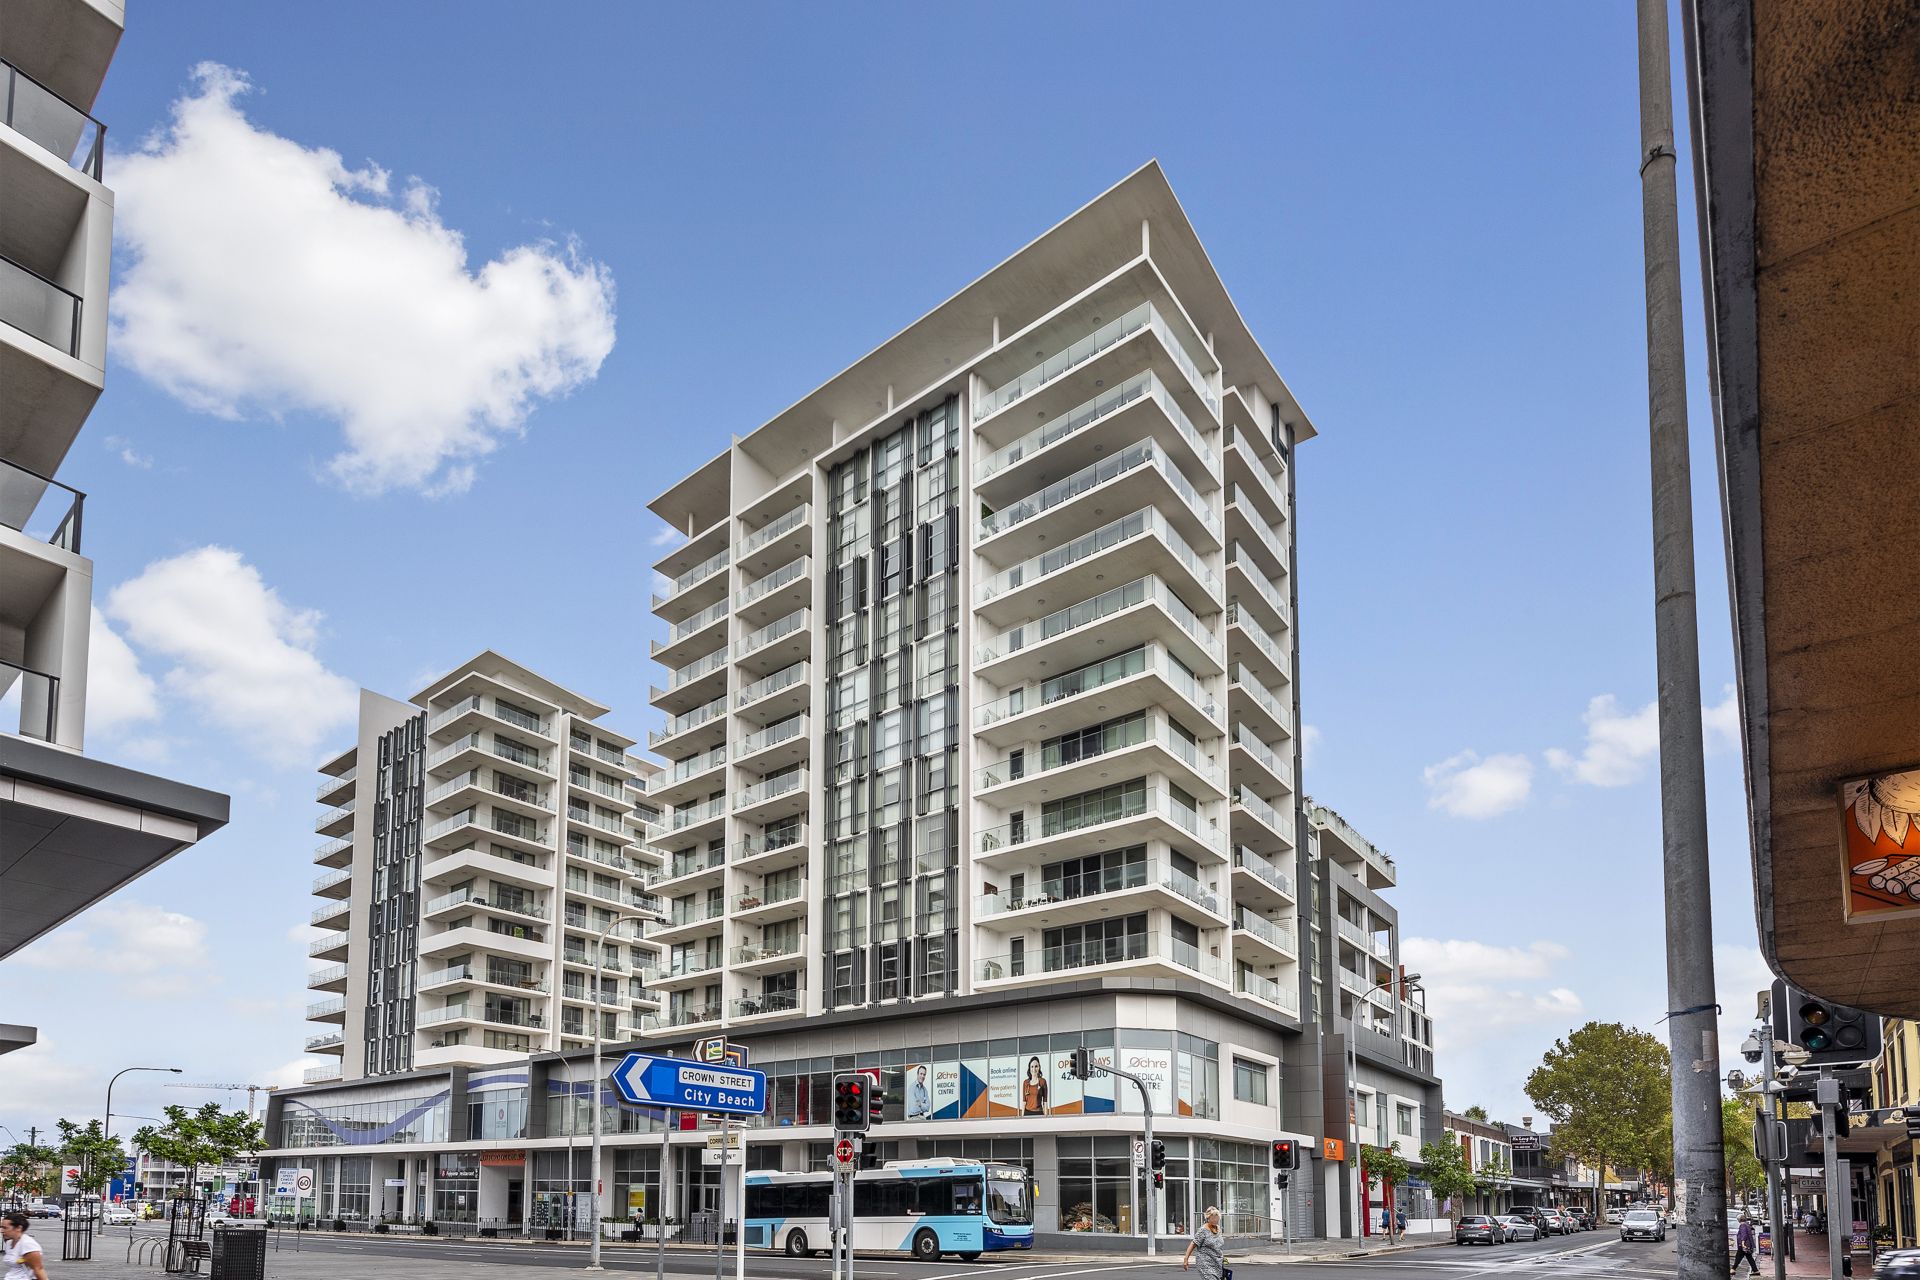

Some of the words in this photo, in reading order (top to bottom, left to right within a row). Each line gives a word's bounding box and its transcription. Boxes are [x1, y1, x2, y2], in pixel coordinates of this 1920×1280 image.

[991, 1067, 1002, 1075] Book
[1003, 1066, 1017, 1074] online
[682, 1071, 715, 1084] CROWN
[719, 1075, 752, 1088] STREET
[1129, 1072, 1164, 1082] EDICAL
[937, 1081, 956, 1089] MEDICAL
[1000, 1084, 1017, 1092] patients
[1131, 1081, 1161, 1090] CTRE
[684, 1089, 712, 1104] City
[718, 1093, 755, 1107] Beach
[838, 1147, 852, 1156] STOP
